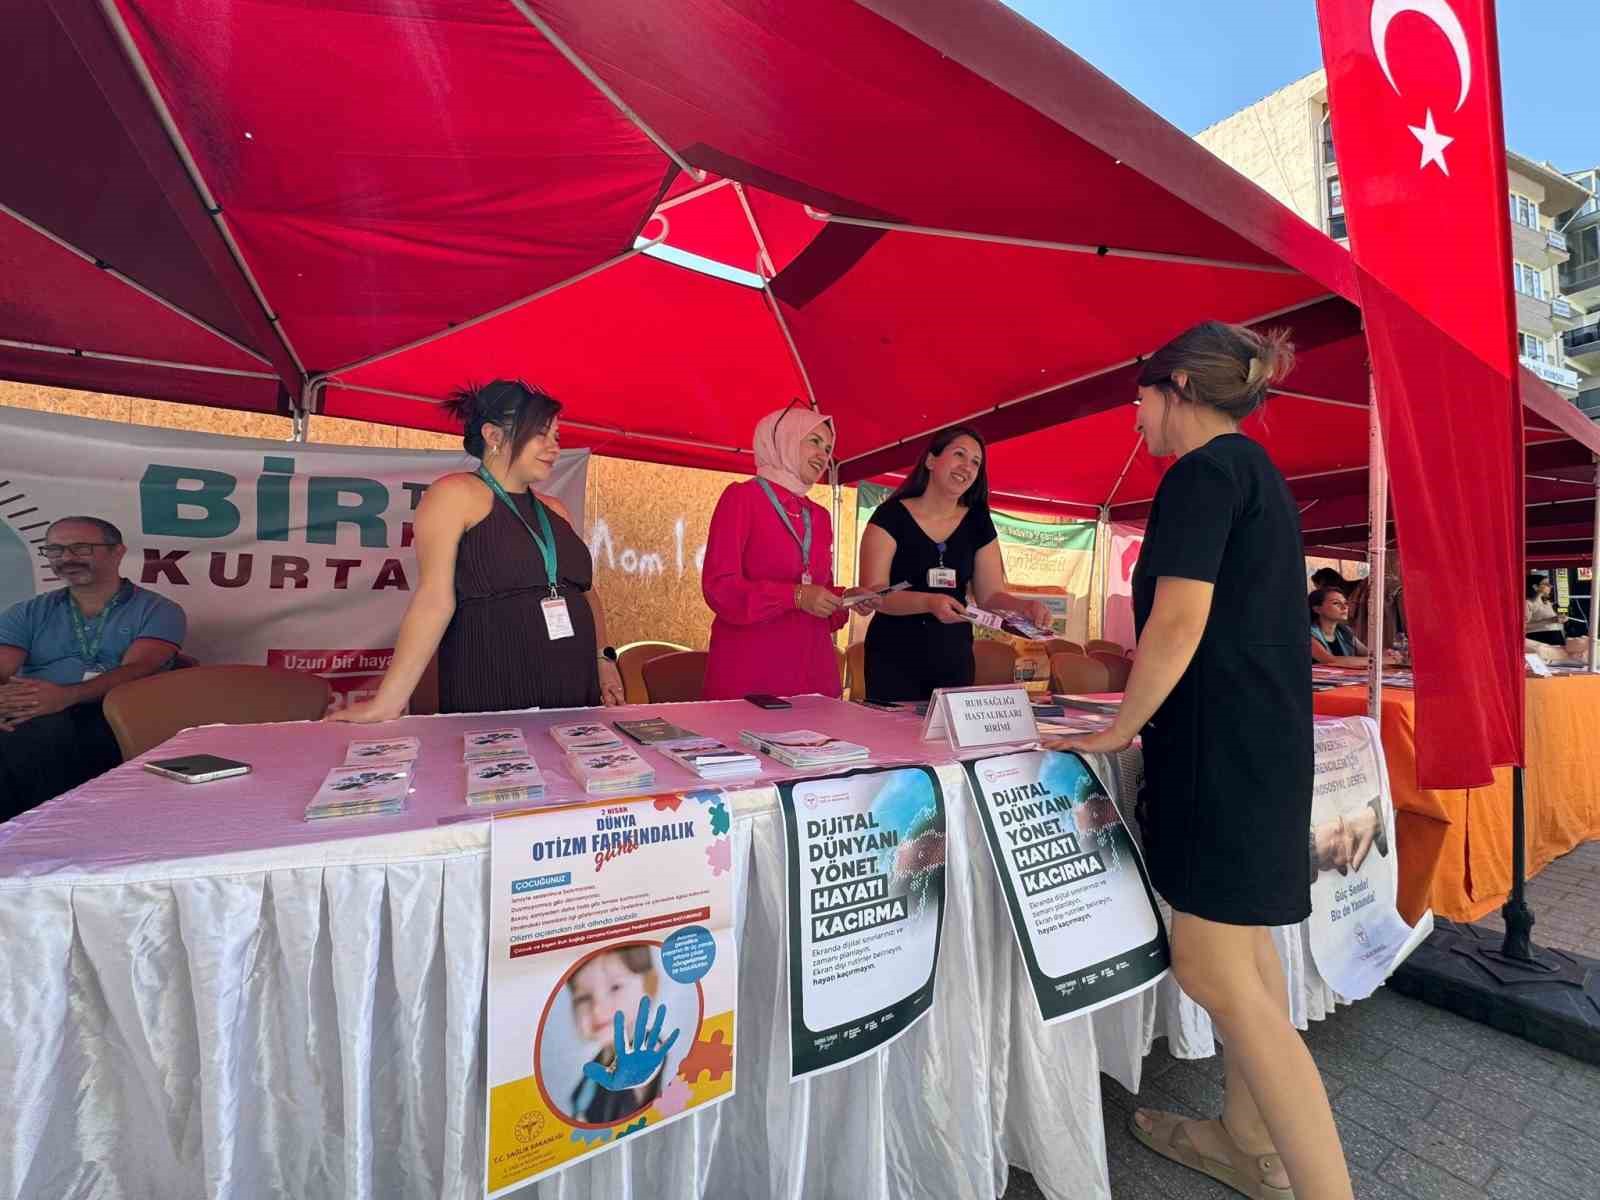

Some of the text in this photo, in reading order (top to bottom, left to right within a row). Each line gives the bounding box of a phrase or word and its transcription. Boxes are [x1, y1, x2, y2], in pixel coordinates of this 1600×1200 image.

[140, 456, 390, 548] BİR
[140, 548, 410, 591] KURTA
[284, 654, 394, 669] Uzun bir haya
[596, 814, 636, 831] DÜNYA
[998, 795, 1073, 827] DÜNYANI
[532, 821, 695, 861] OTİZM FARKINDALIK
[809, 830, 898, 862] DÜNYANI
[1015, 837, 1076, 868] HAYATI
[814, 878, 883, 910] HAYATI
